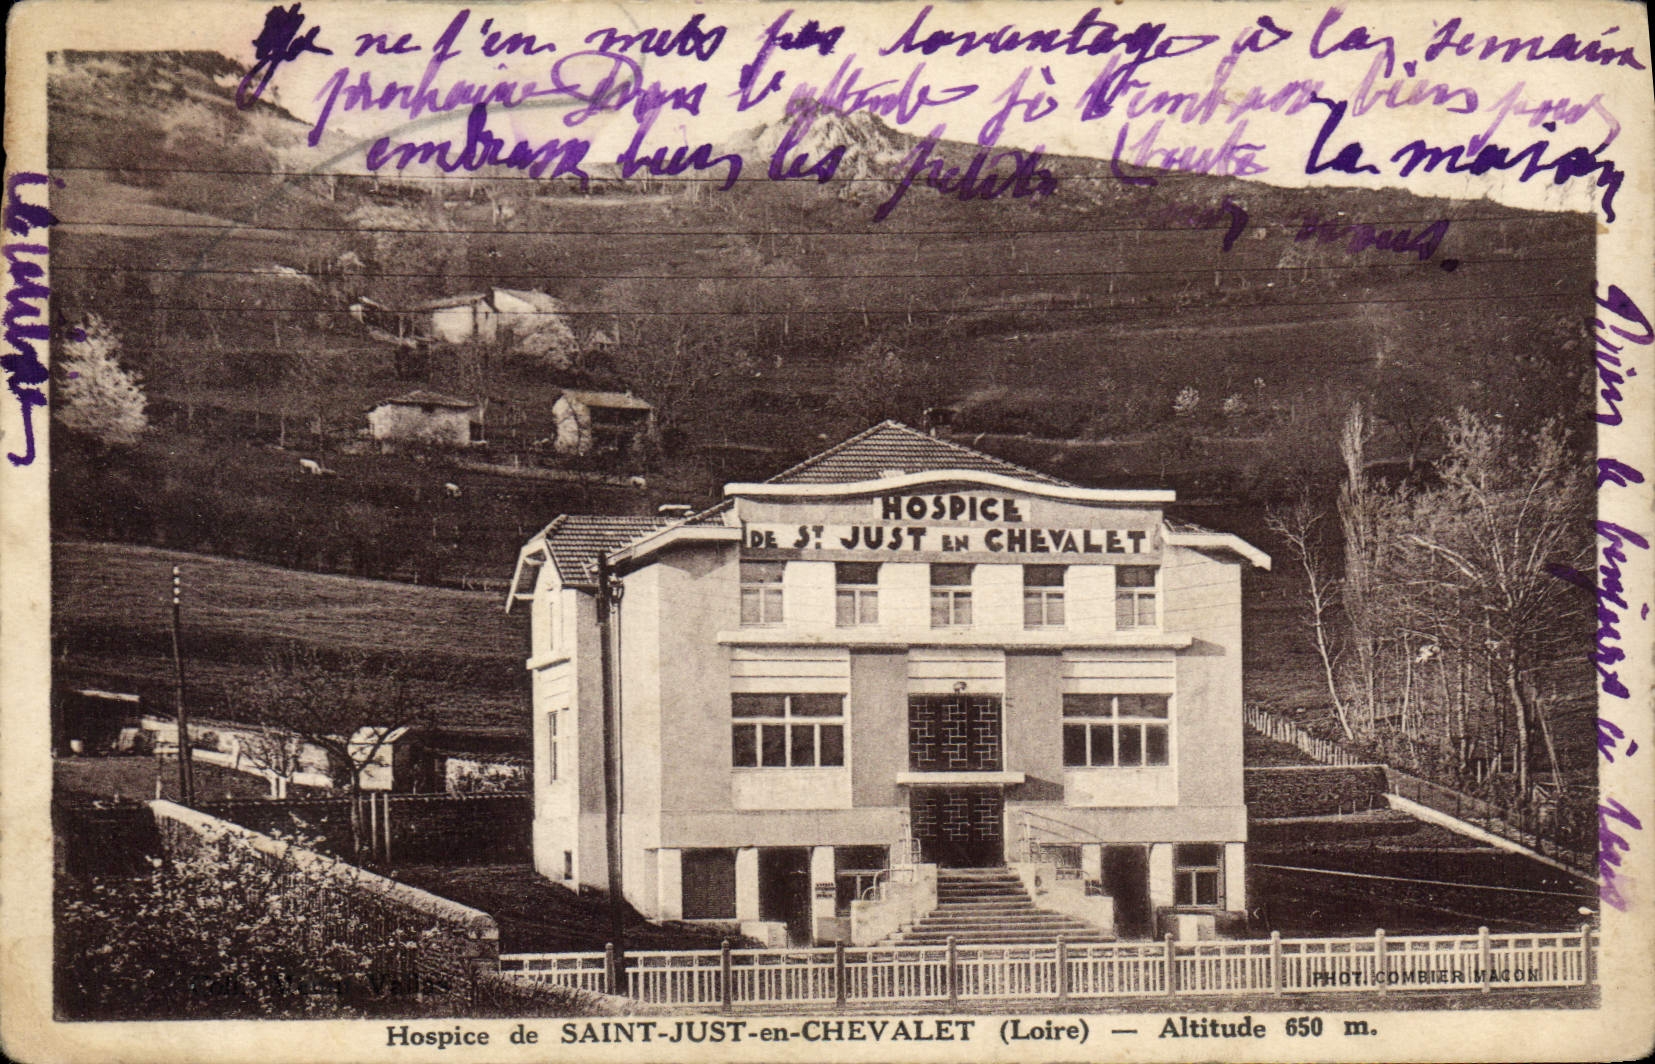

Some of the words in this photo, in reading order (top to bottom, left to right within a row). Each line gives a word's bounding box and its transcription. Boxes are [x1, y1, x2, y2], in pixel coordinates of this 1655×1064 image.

[355, 34, 421, 57] ne
[881, 495, 1024, 523] HOSPICE
[750, 529, 779, 550] DE
[840, 525, 927, 551] JUST
[942, 534, 970, 552] EN
[984, 528, 1147, 554] CHEVALET
